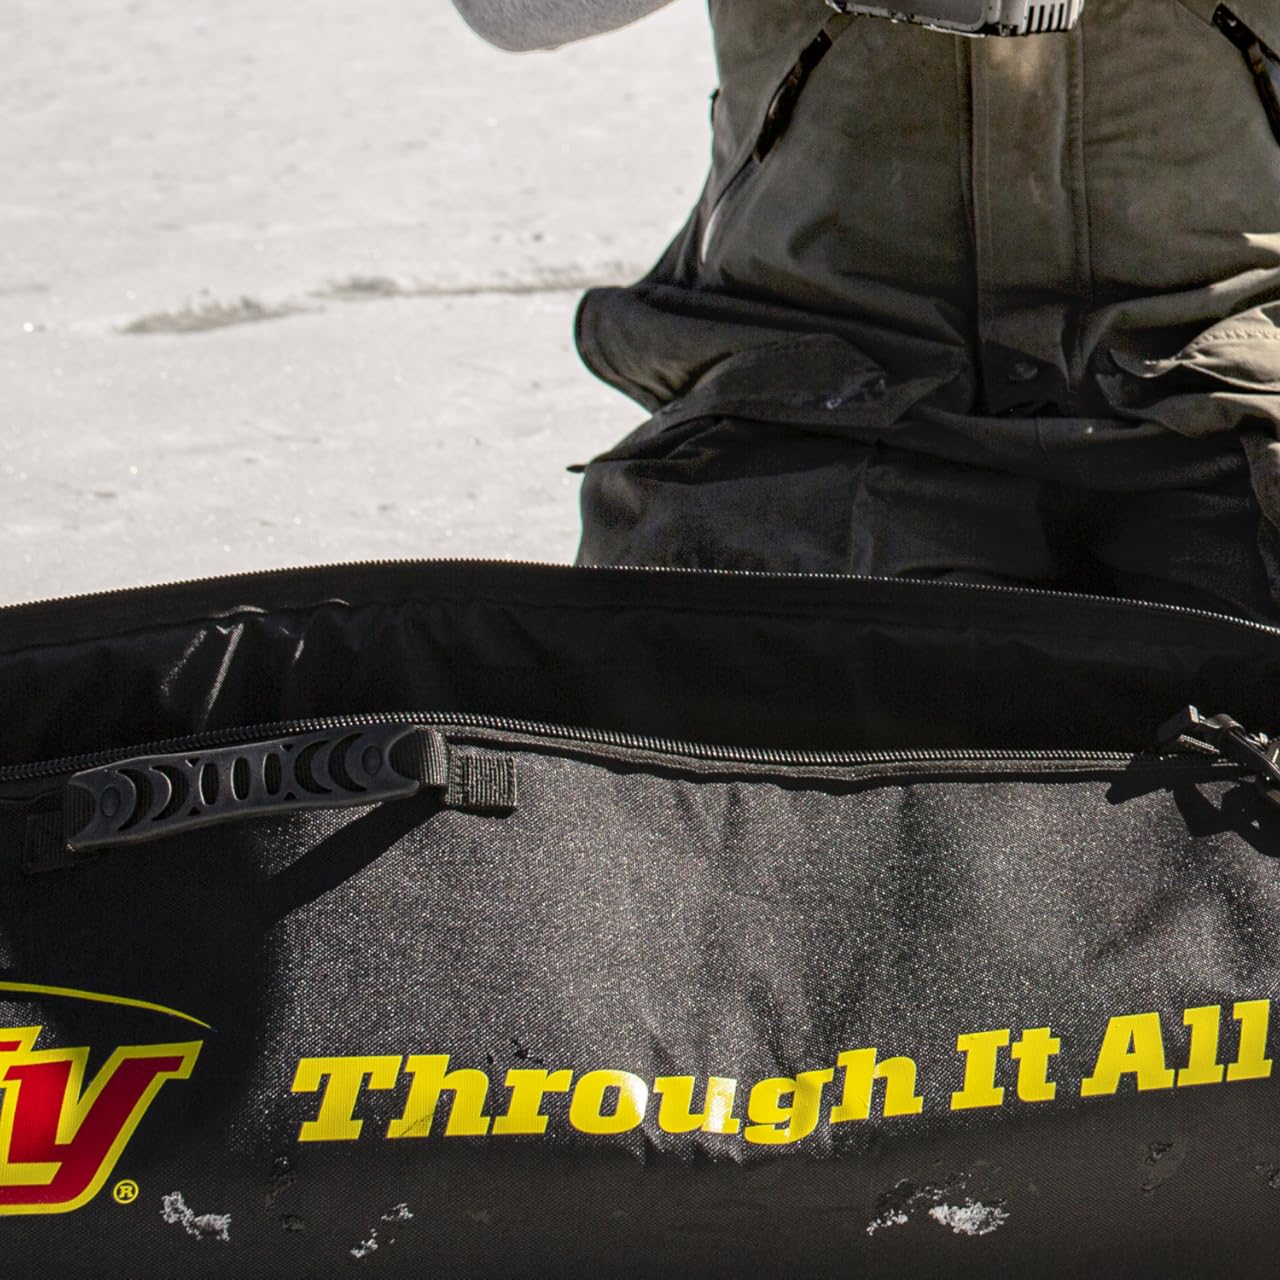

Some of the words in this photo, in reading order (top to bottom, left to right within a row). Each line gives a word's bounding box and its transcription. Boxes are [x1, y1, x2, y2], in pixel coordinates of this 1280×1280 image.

[290, 1046, 923, 1146] Through
[949, 1027, 1061, 1111] It
[1080, 998, 1273, 1098] All
